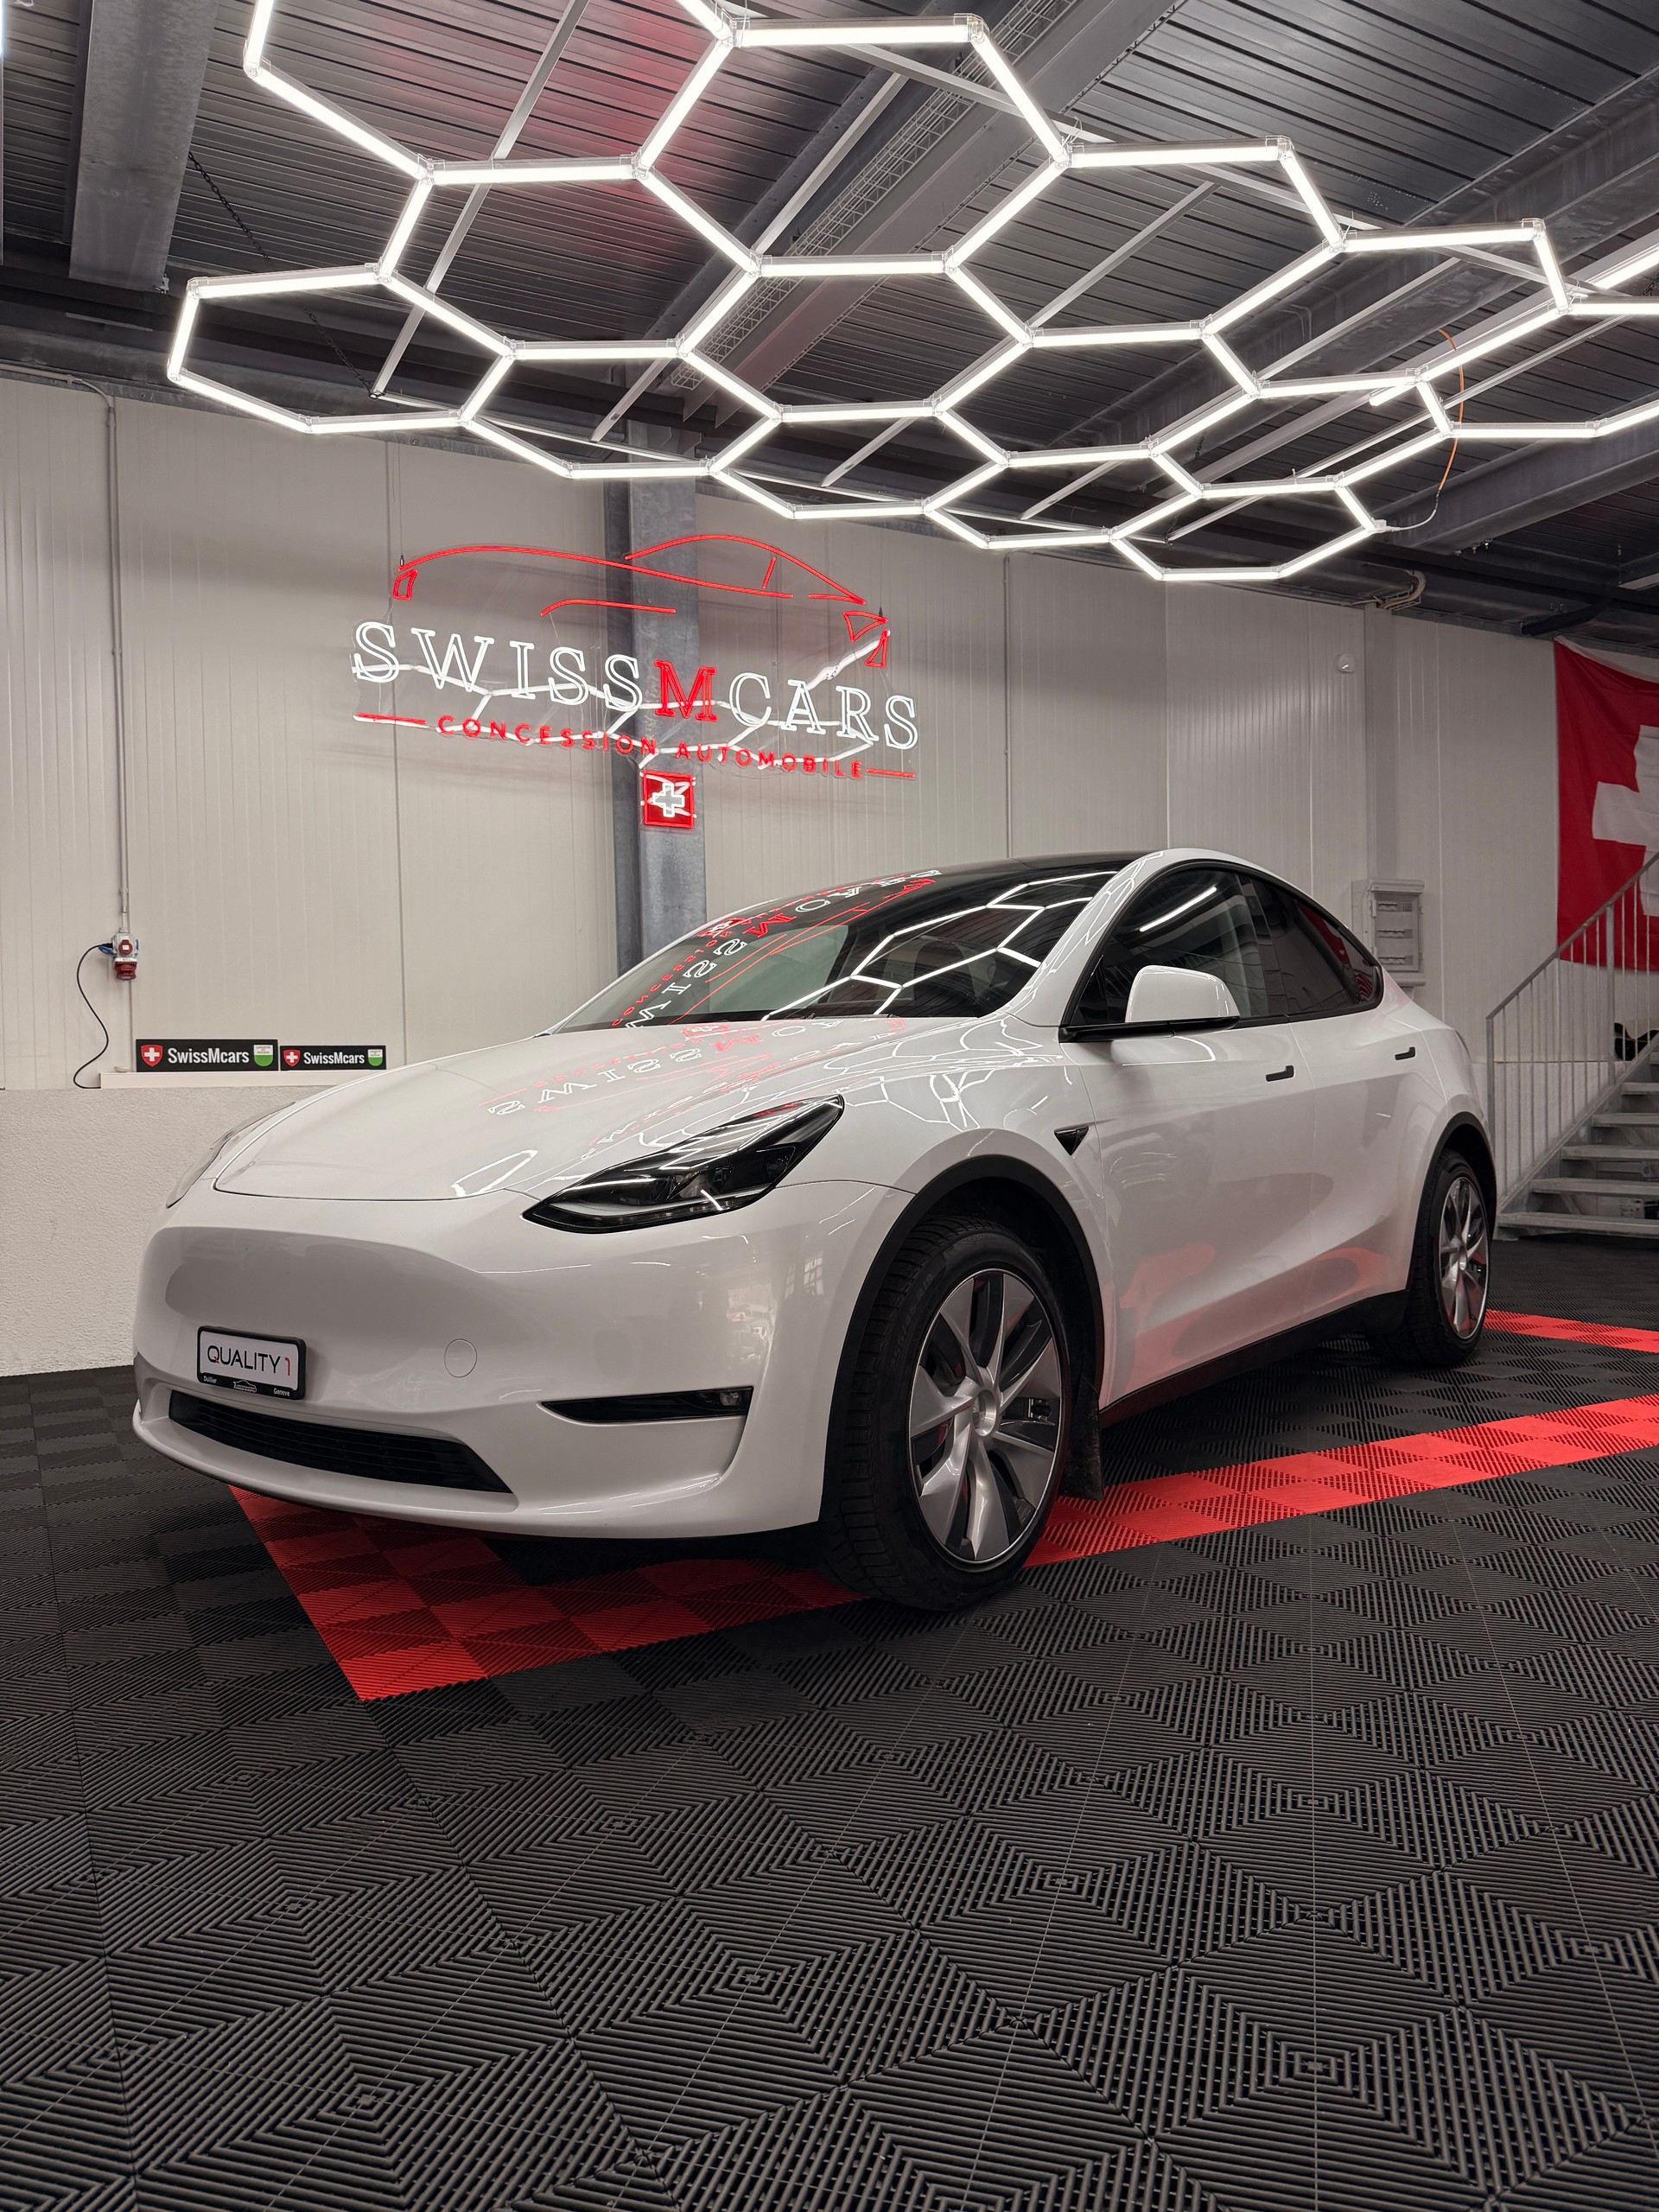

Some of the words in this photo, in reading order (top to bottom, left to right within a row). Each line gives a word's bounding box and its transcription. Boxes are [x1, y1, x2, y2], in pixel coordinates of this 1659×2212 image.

[437, 715, 658, 756] CONCESSION
[675, 741, 863, 779] AUTOMOBILE
[168, 1047, 250, 1065] SwissMcars
[303, 1051, 365, 1065] SwissMcars
